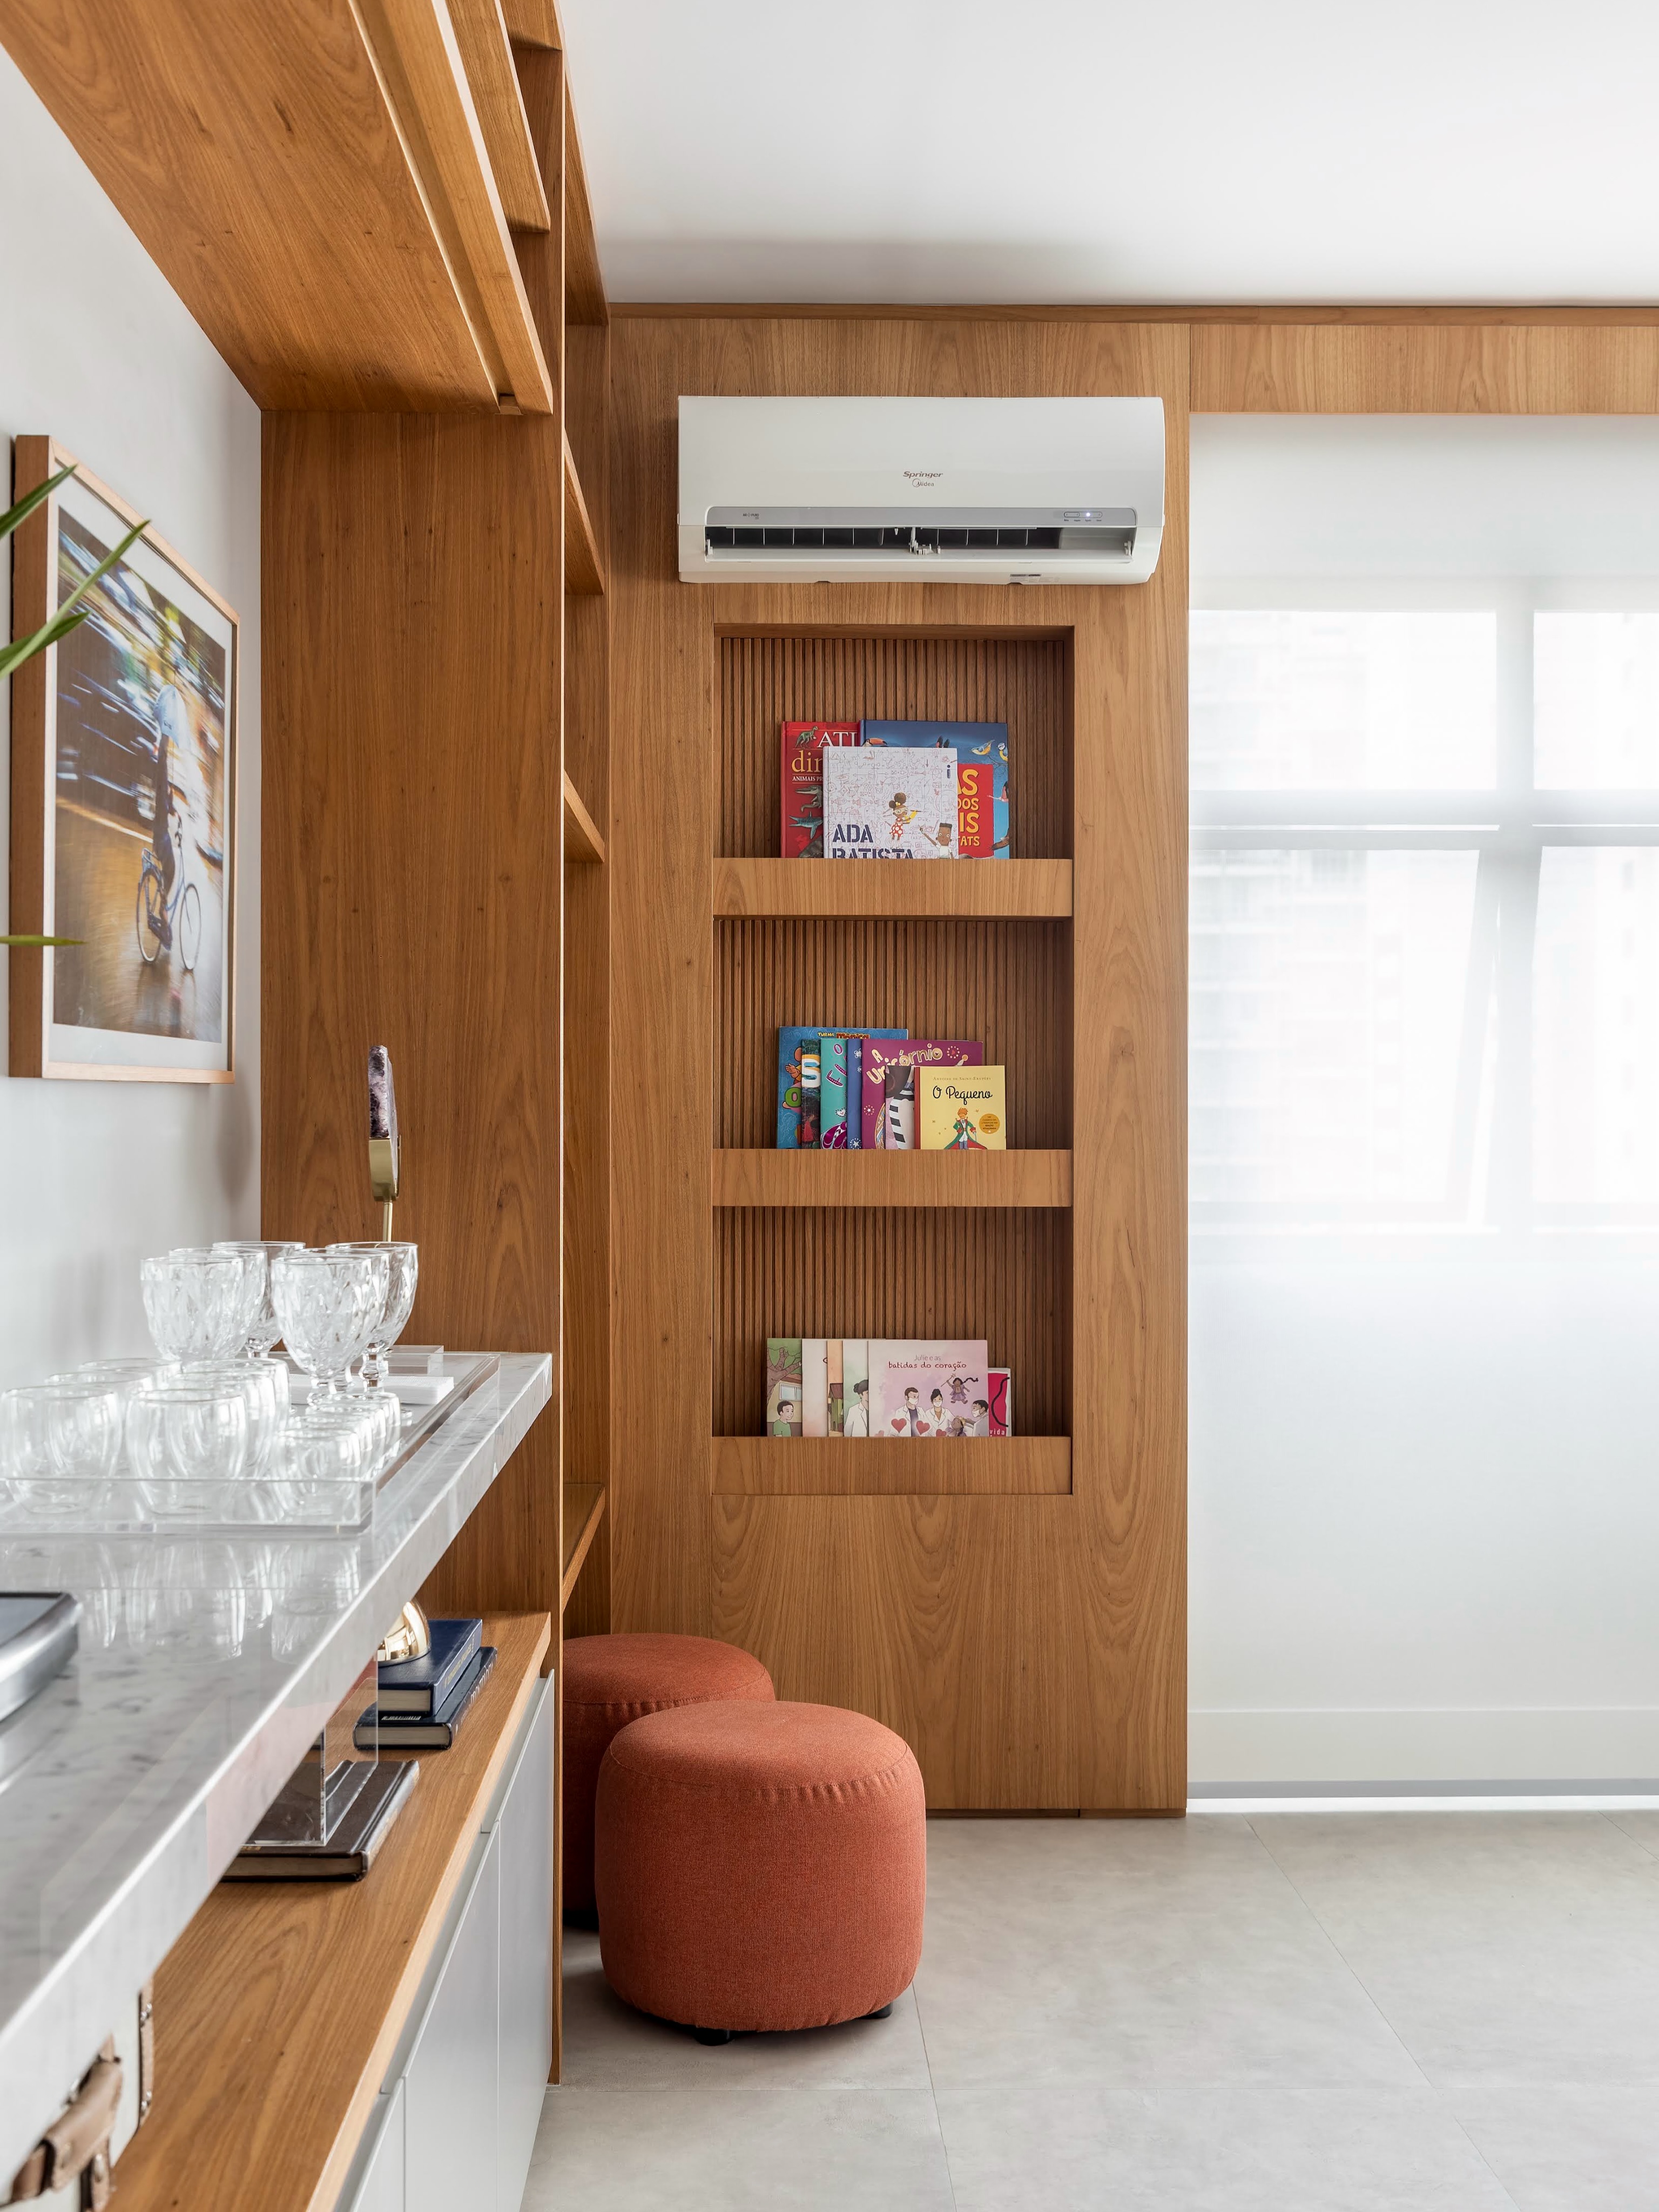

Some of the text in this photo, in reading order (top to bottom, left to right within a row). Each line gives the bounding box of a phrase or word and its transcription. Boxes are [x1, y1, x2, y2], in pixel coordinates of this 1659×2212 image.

[912, 479, 934, 487] Midea
[833, 824, 874, 843] ADA
[871, 1049, 883, 1063] A
[933, 1085, 993, 1105] O Pequeno
[935, 1361, 967, 1372] coração
